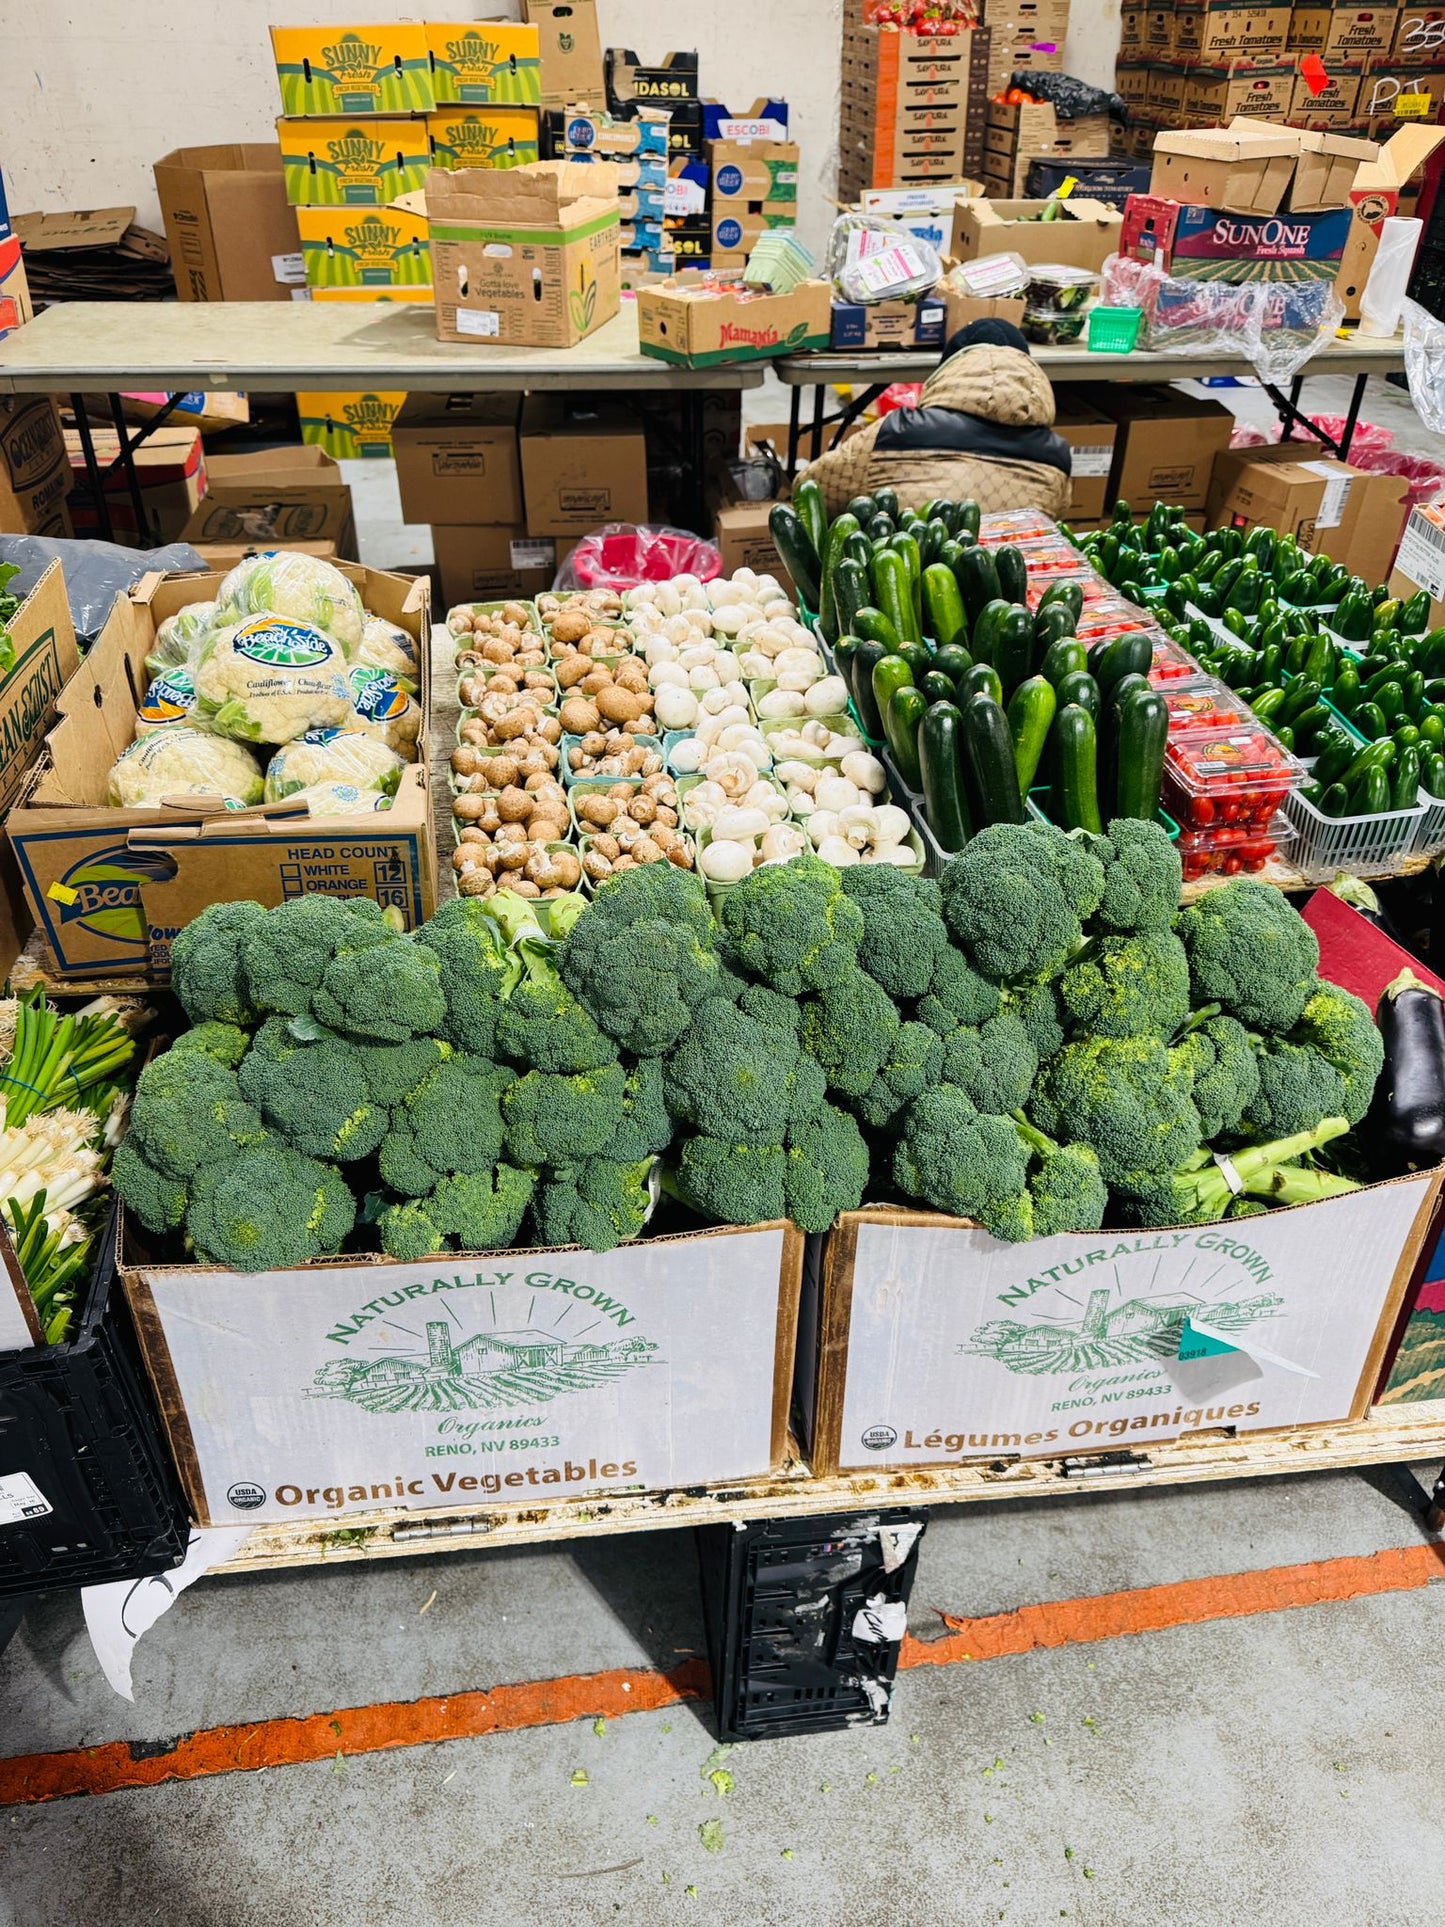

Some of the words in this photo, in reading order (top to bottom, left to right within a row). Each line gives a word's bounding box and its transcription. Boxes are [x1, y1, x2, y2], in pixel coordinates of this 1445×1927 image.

[1349, 24, 1376, 35] Fresh
[1210, 35, 1237, 46] Fresh
[1239, 34, 1283, 44] Tomatoes
[1336, 35, 1383, 45] Tomatoes
[321, 44, 382, 66] SUNNY
[446, 40, 500, 61] SUNNY
[340, 70, 372, 79] Fresh
[1246, 91, 1273, 102] Fresh
[1302, 97, 1345, 108] Tomatoes
[1235, 102, 1281, 113] Tomatoes
[446, 125, 498, 144] SUNNY
[727, 125, 770, 135] ESCOBI
[327, 140, 385, 160] SUNNY
[344, 163, 375, 173] Fresh
[344, 225, 401, 245] SUNNY
[361, 248, 390, 257] Fresh
[1256, 245, 1277, 255] Fresh
[1279, 245, 1306, 256] Squash
[480, 279, 500, 289] Gotta
[501, 281, 519, 289] love
[475, 289, 525, 299] Vegetables
[343, 403, 400, 421] SUNNY
[288, 848, 335, 860] HEAD
[340, 846, 398, 859] COUNT
[304, 864, 350, 876] WHITE
[378, 864, 402, 882] 12
[306, 879, 368, 891] ORANGE
[380, 889, 404, 906] 16
[995, 1233, 1189, 1308] NATURALLY
[1195, 1232, 1274, 1285] GROWN
[325, 1272, 514, 1345] NATURALLY
[524, 1272, 637, 1328] GROWN
[1179, 1347, 1207, 1361] 03918
[1068, 1366, 1168, 1392] Organics
[1051, 1397, 1097, 1412] RENO,
[1100, 1391, 1124, 1404] NV
[1126, 1384, 1172, 1400] 89433
[437, 1415, 549, 1441] Organics
[904, 1426, 1058, 1453] Légumes
[1067, 1399, 1261, 1437] Organiques
[869, 1431, 890, 1439] USDA
[424, 1441, 476, 1457] RENO,
[481, 1440, 506, 1452] NV
[509, 1436, 561, 1450] 89433
[274, 1475, 425, 1508] Organic
[432, 1458, 638, 1494] Vegetables
[235, 1489, 257, 1497] USDA
